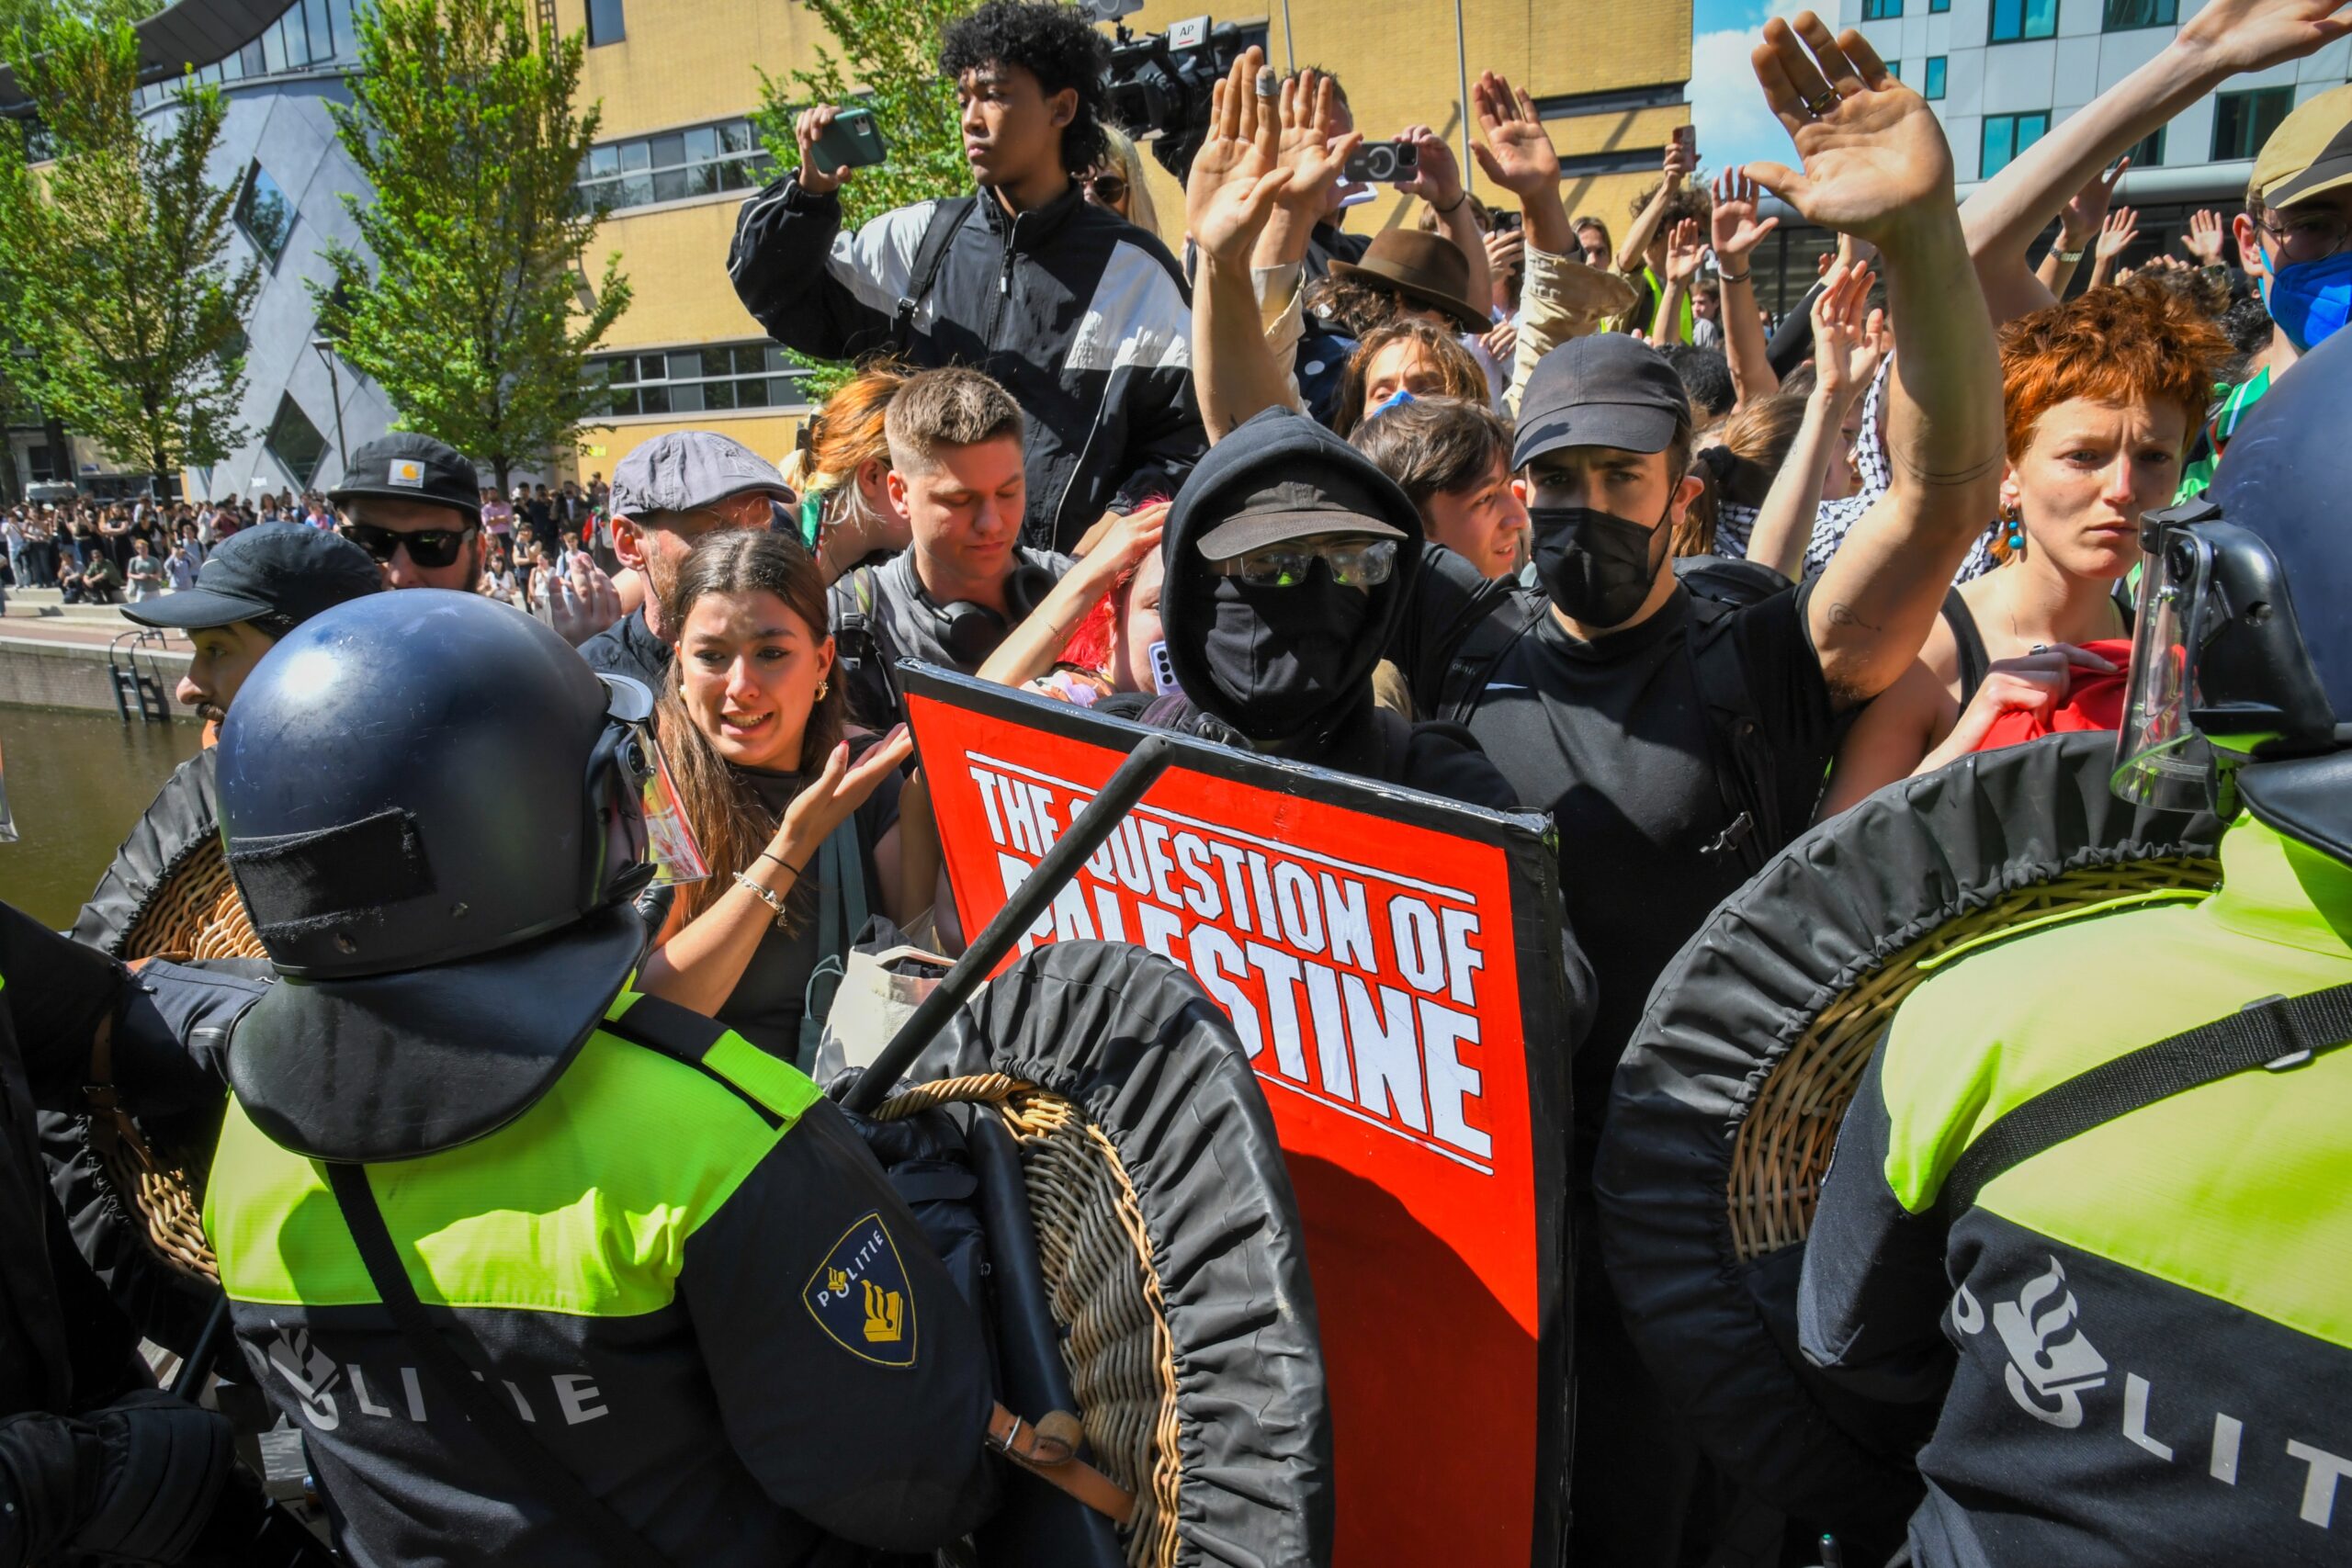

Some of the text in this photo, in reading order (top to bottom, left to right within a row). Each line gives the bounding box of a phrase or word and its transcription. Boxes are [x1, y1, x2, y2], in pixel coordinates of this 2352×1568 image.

[1179, 24, 1195, 37] AP
[969, 766, 1484, 1009] THE QUESTION OF
[817, 1230, 884, 1308] POLITIE
[241, 1337, 609, 1431] POLIIE
